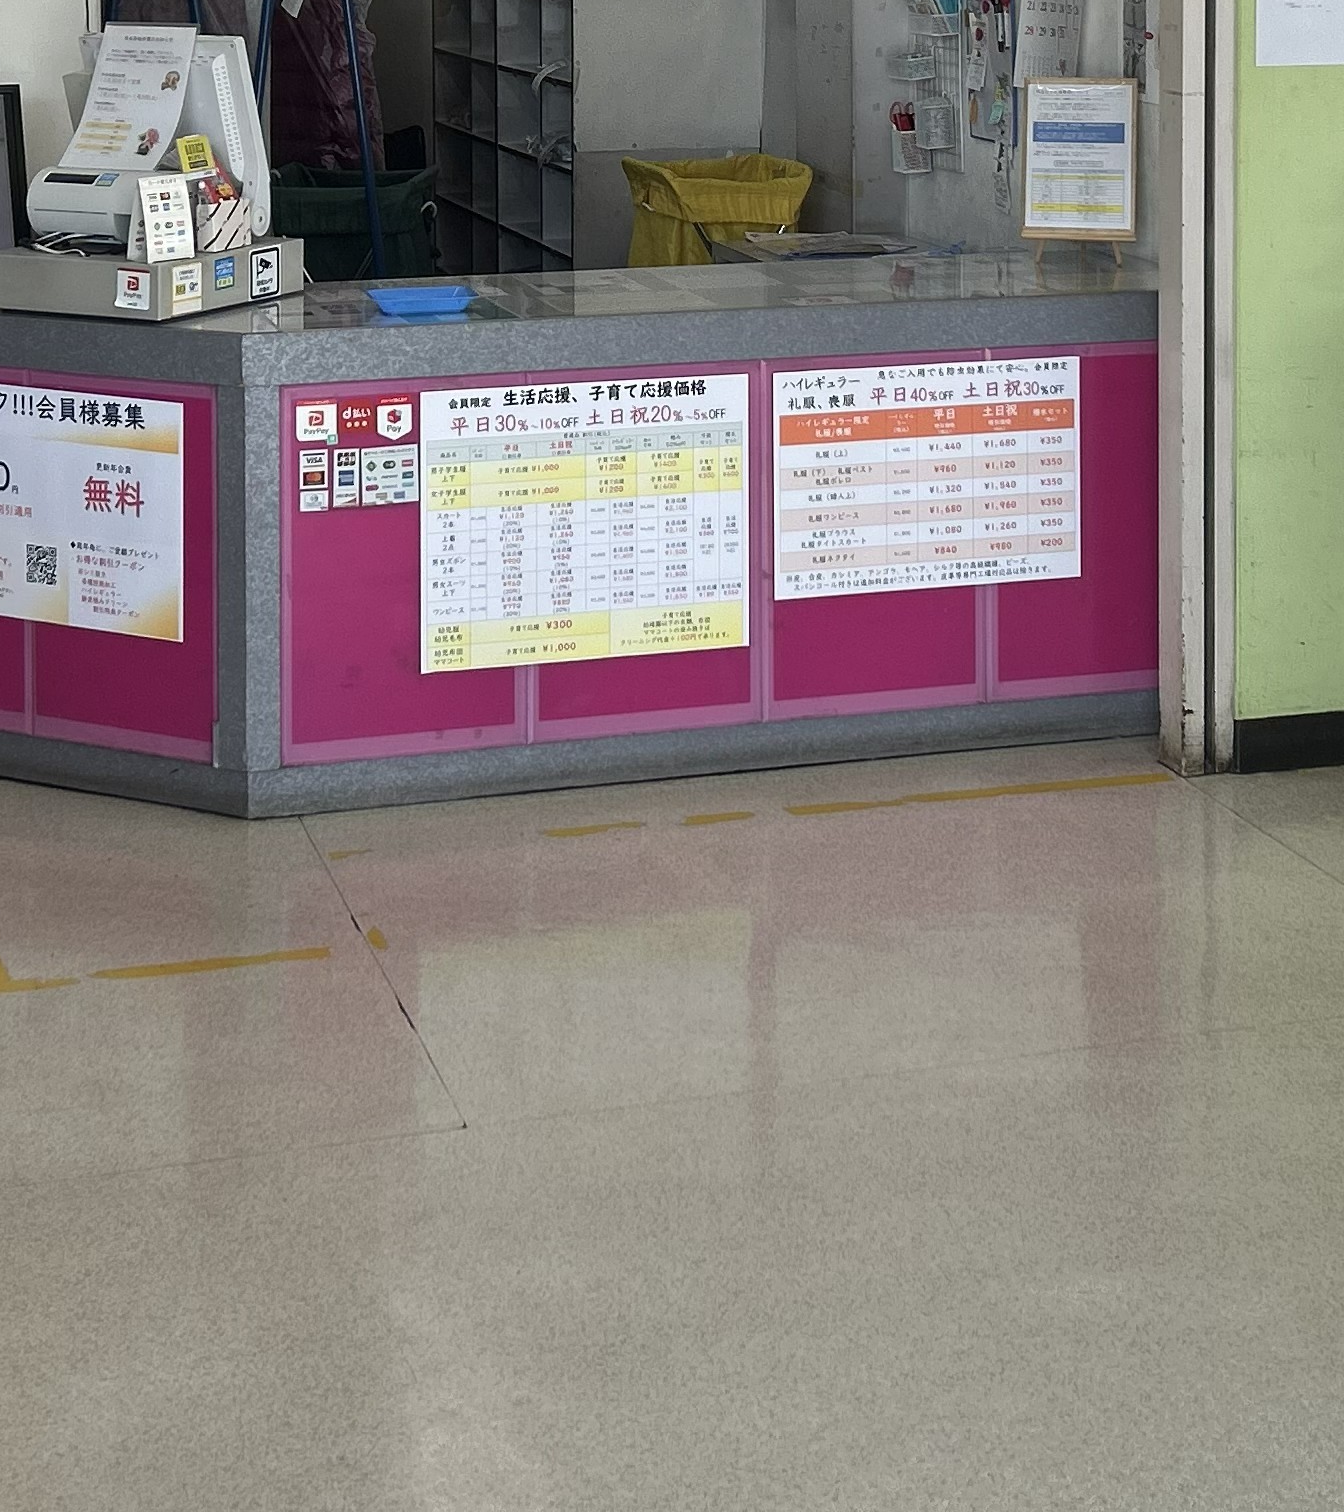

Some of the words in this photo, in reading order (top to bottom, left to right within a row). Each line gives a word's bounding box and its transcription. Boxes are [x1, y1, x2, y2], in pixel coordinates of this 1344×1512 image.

[782, 376, 860, 390] ハイレギュラー
[448, 397, 491, 409] 会員限定
[503, 380, 706, 406] 生活応援、子育て応援価格
[934, 408, 955, 420] 平日
[982, 404, 1017, 417] 土日祝
[984, 439, 1016, 449] ¥1,680
[1040, 436, 1062, 444] ¥350
[934, 464, 956, 473] ¥960
[1040, 458, 1062, 466] ¥350
[1040, 478, 1062, 486] ¥350
[83, 475, 144, 518] 無料
[1041, 498, 1062, 506] ¥350
[1041, 518, 1062, 526] ¥350
[1041, 538, 1063, 547] ¥200
[546, 620, 572, 629] ¥300
[543, 642, 576, 652] ¥1,000
